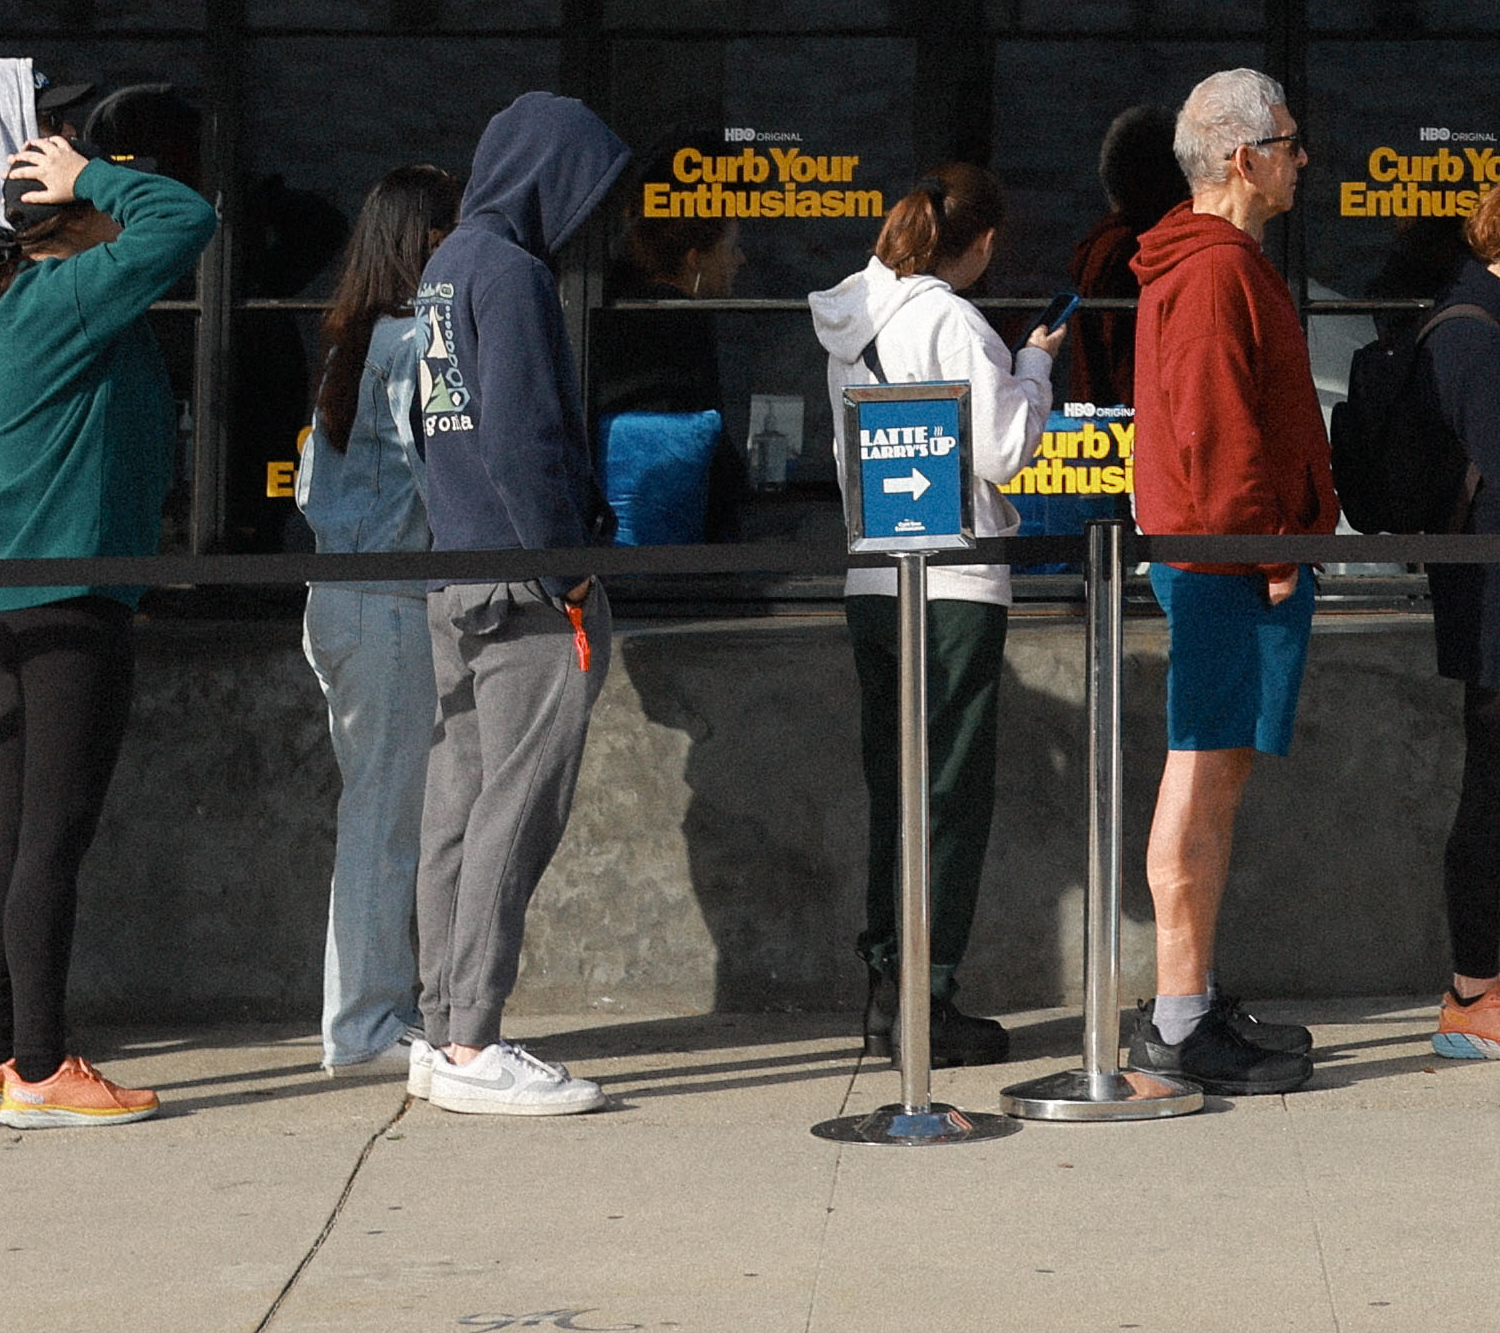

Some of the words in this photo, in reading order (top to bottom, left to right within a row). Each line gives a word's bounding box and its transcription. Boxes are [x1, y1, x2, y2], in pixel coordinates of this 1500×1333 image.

[725, 128, 755, 142] HBO
[757, 132, 803, 142] ORIGINAL
[1420, 127, 1450, 141] HBO
[1451, 132, 1498, 142] ORIGINAL
[673, 147, 770, 183] Curb
[769, 148, 859, 183] Your
[1368, 146, 1464, 182] Curb
[644, 182, 883, 218] Enthusiasm
[1063, 402, 1096, 417] HBO
[1096, 407, 1135, 418] ORIGINA
[860, 426, 928, 447] LATTE
[929, 436, 957, 456] UP
[1033, 422, 1111, 459] urb
[861, 444, 929, 460] LARRY'S
[996, 458, 1135, 494] nthusi
